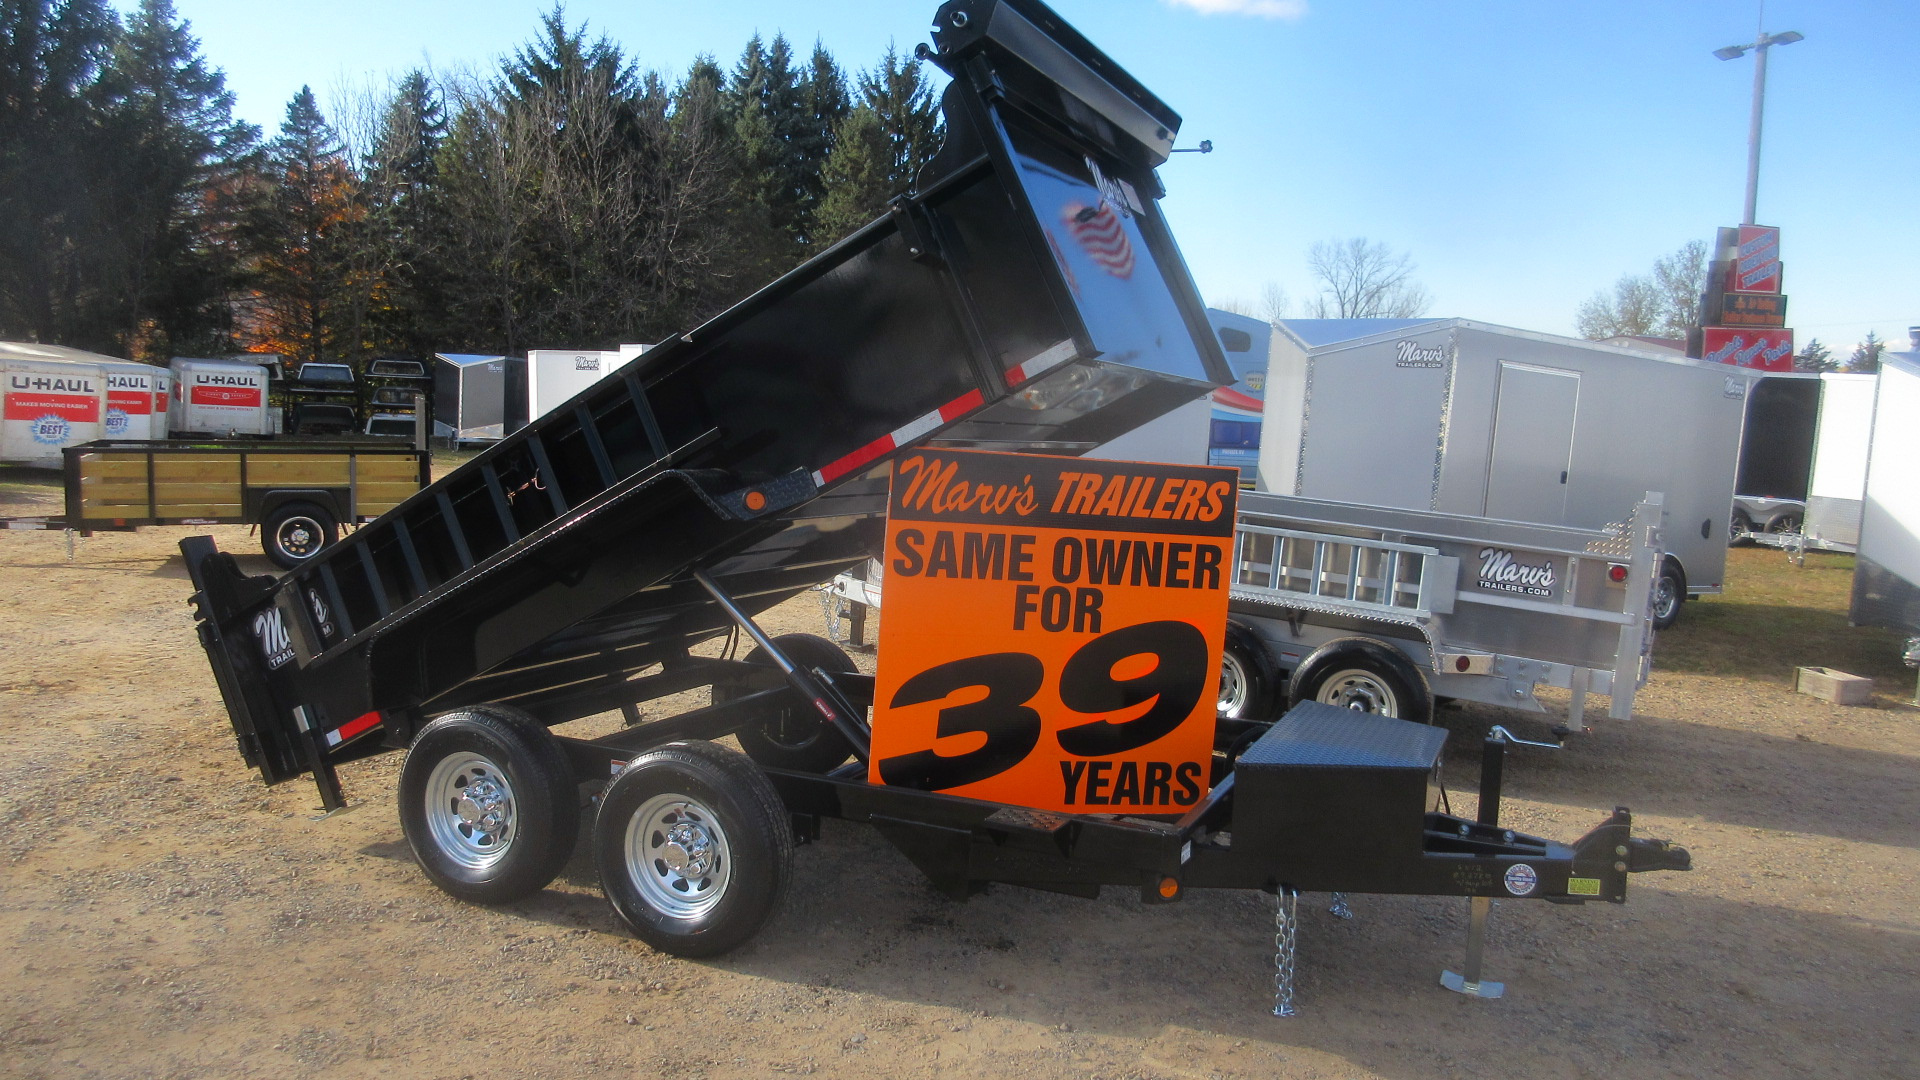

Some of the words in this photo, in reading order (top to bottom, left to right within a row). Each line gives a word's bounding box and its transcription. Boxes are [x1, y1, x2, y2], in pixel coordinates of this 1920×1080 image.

[1397, 340, 1445, 362] Marv's
[12, 375, 95, 393] U-HAUL
[197, 374, 258, 386] U-HAUL
[39, 424, 64, 435] BEST
[900, 455, 1039, 516] Marv's
[1050, 471, 1231, 522] TRAILERS
[893, 528, 1037, 582] SAME
[1052, 536, 1223, 590] OWNER
[1479, 547, 1555, 587] Marv's
[1479, 580, 1549, 597] TRAILERS.COM
[1012, 584, 1105, 634] FOR
[878, 620, 1209, 793] 39
[1059, 760, 1202, 806] YEARS
